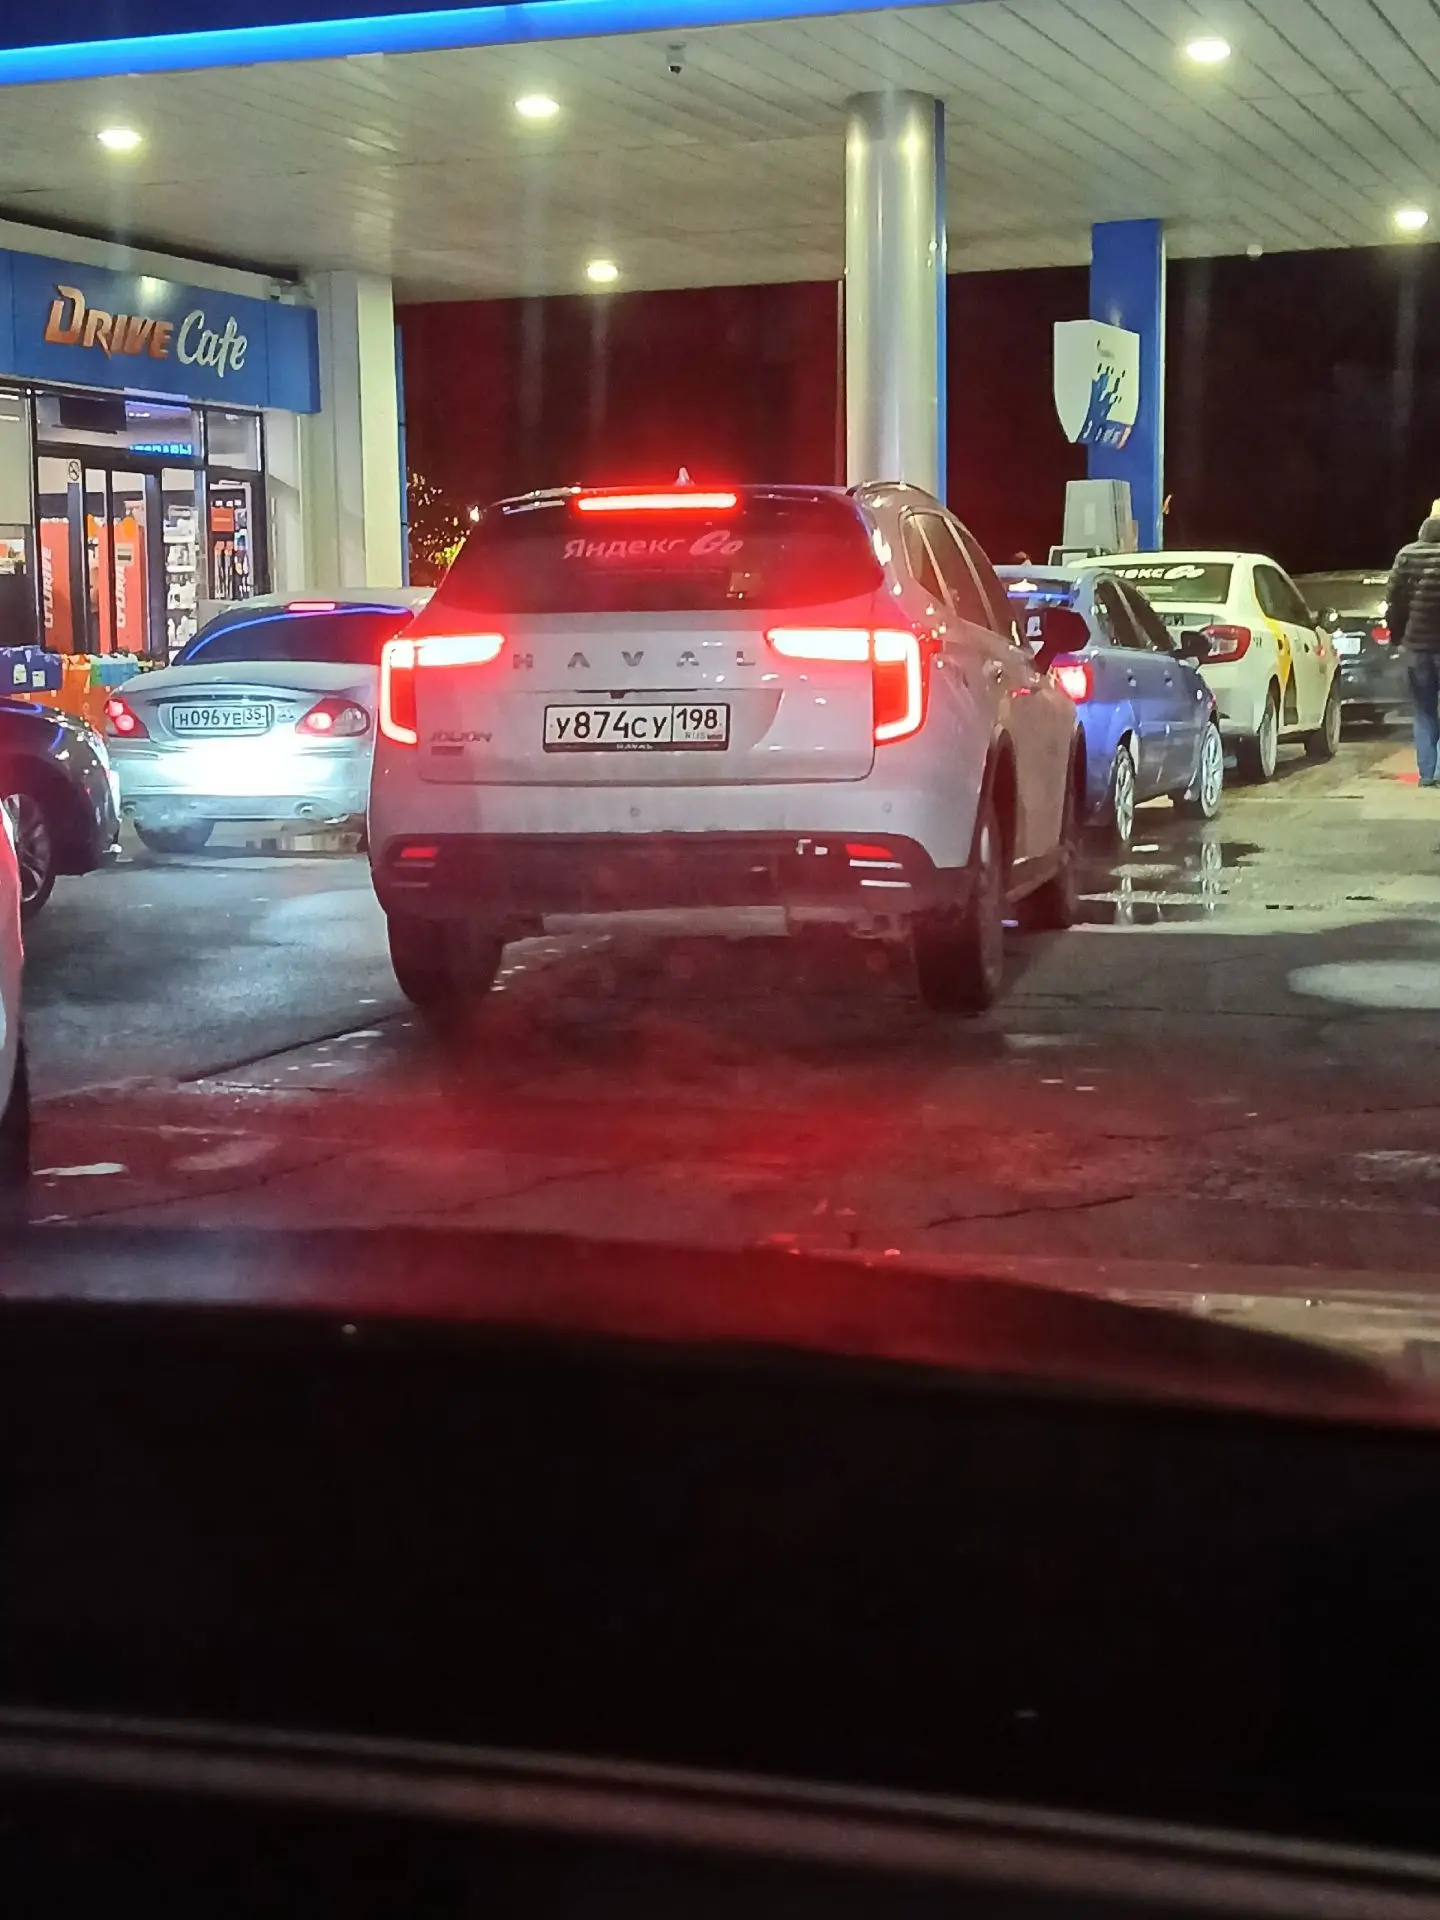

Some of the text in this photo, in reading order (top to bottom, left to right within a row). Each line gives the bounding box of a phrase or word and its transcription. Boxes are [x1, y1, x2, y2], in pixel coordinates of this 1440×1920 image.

[44, 284, 248, 379] DRIVE Cafe
[689, 529, 745, 557] Go
[512, 650, 757, 670] HAVAL
[180, 709, 242, 726] Н096УЕ
[246, 707, 262, 721] 35
[556, 707, 718, 740] У874СУ 198
